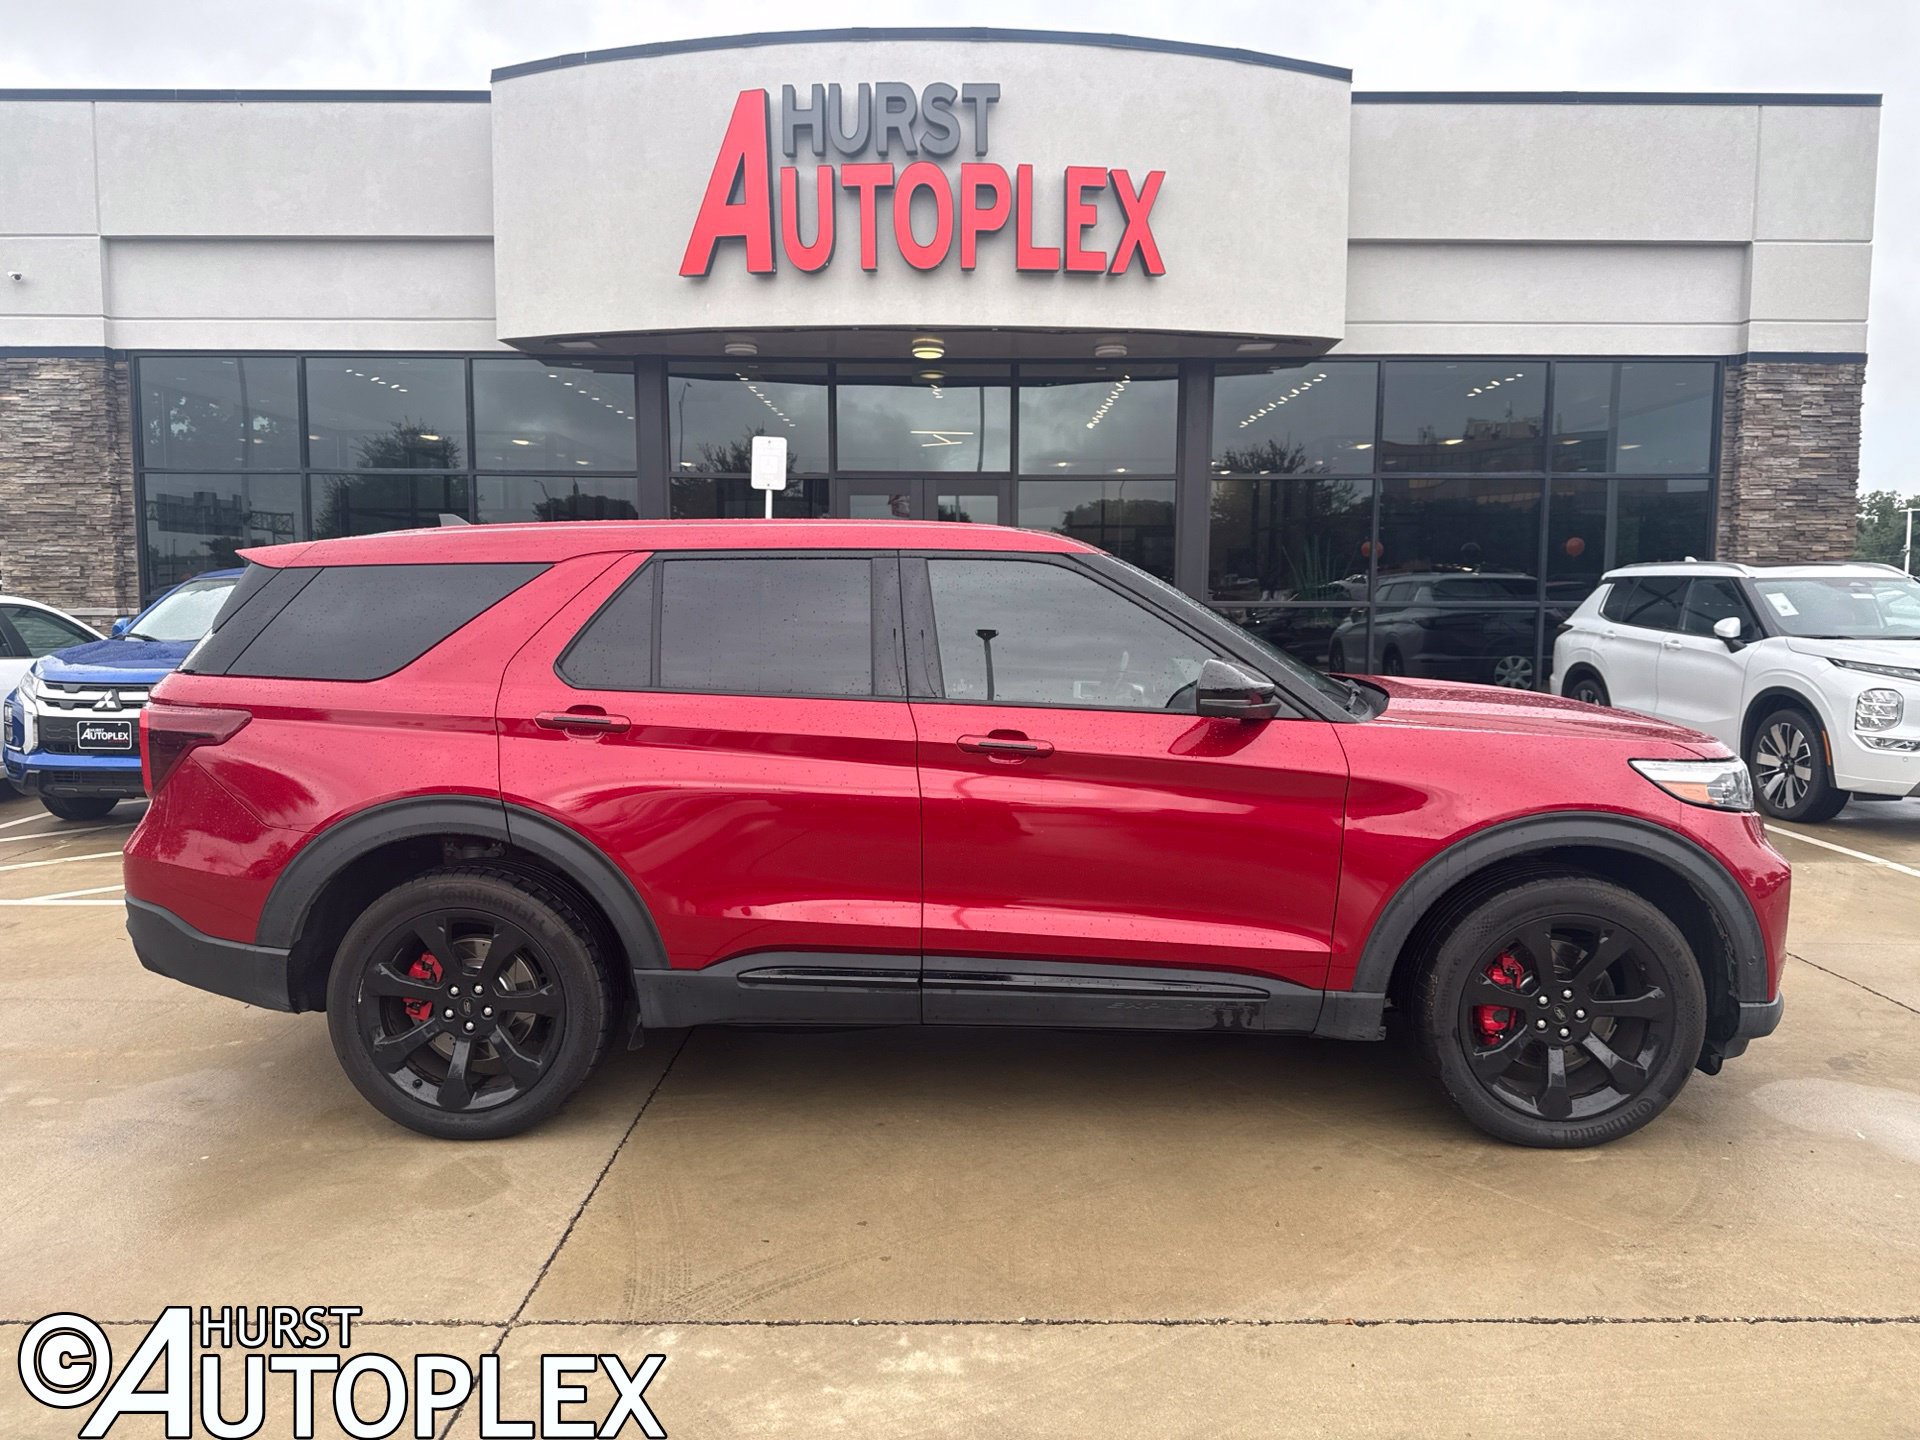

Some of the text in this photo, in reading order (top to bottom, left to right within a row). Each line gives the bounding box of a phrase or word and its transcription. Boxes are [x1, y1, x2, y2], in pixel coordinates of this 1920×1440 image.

[782, 82, 1001, 157] HURST
[679, 88, 1166, 277] AUTOPLEX
[81, 728, 128, 740] AUTOPLEX
[1562, 1097, 1656, 1141] Continental
